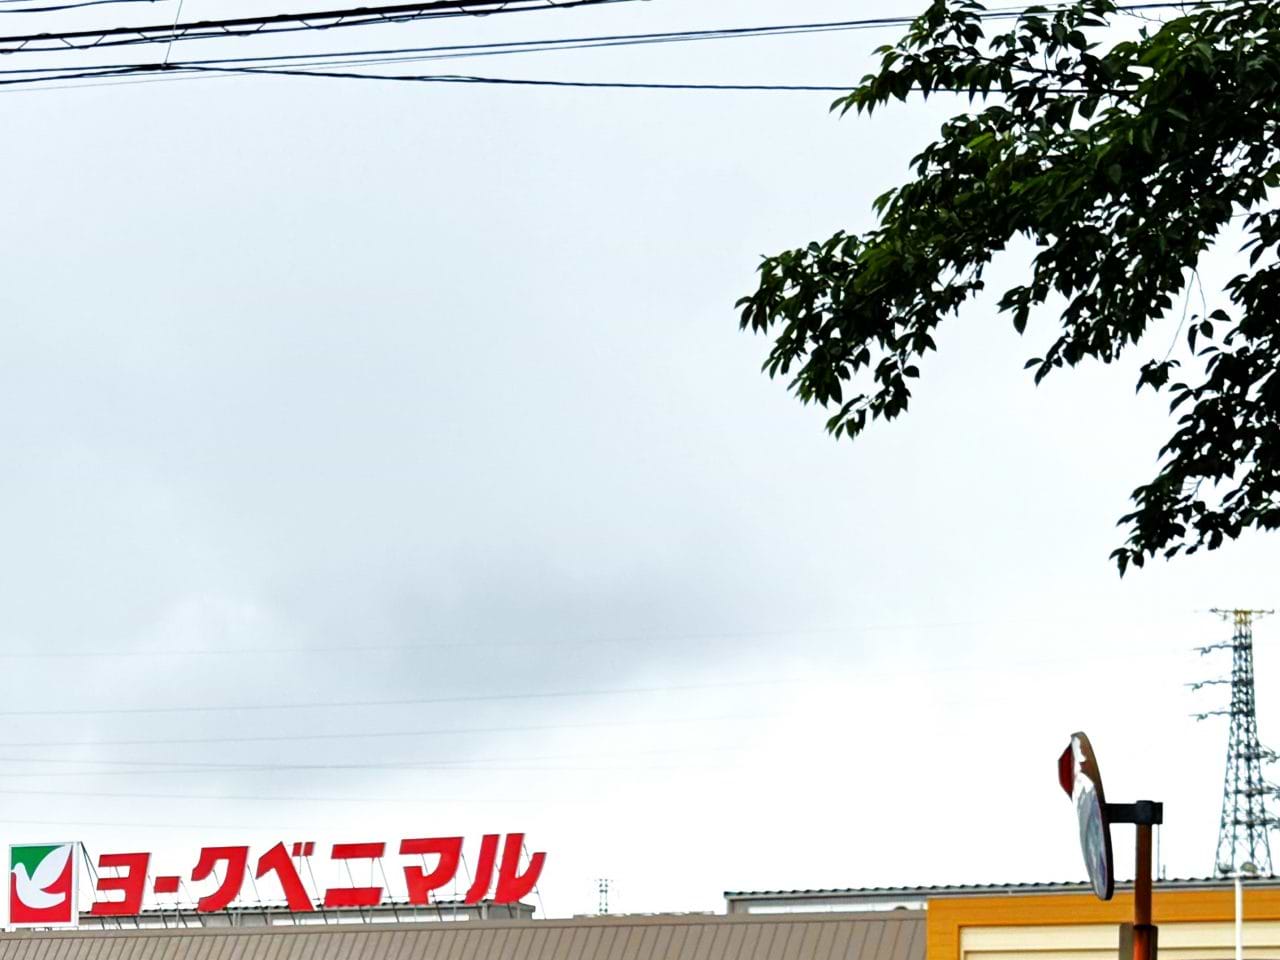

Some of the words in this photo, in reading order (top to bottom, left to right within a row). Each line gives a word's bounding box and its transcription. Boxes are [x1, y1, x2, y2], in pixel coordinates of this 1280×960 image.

[91, 833, 547, 915] ヨークベニマル
